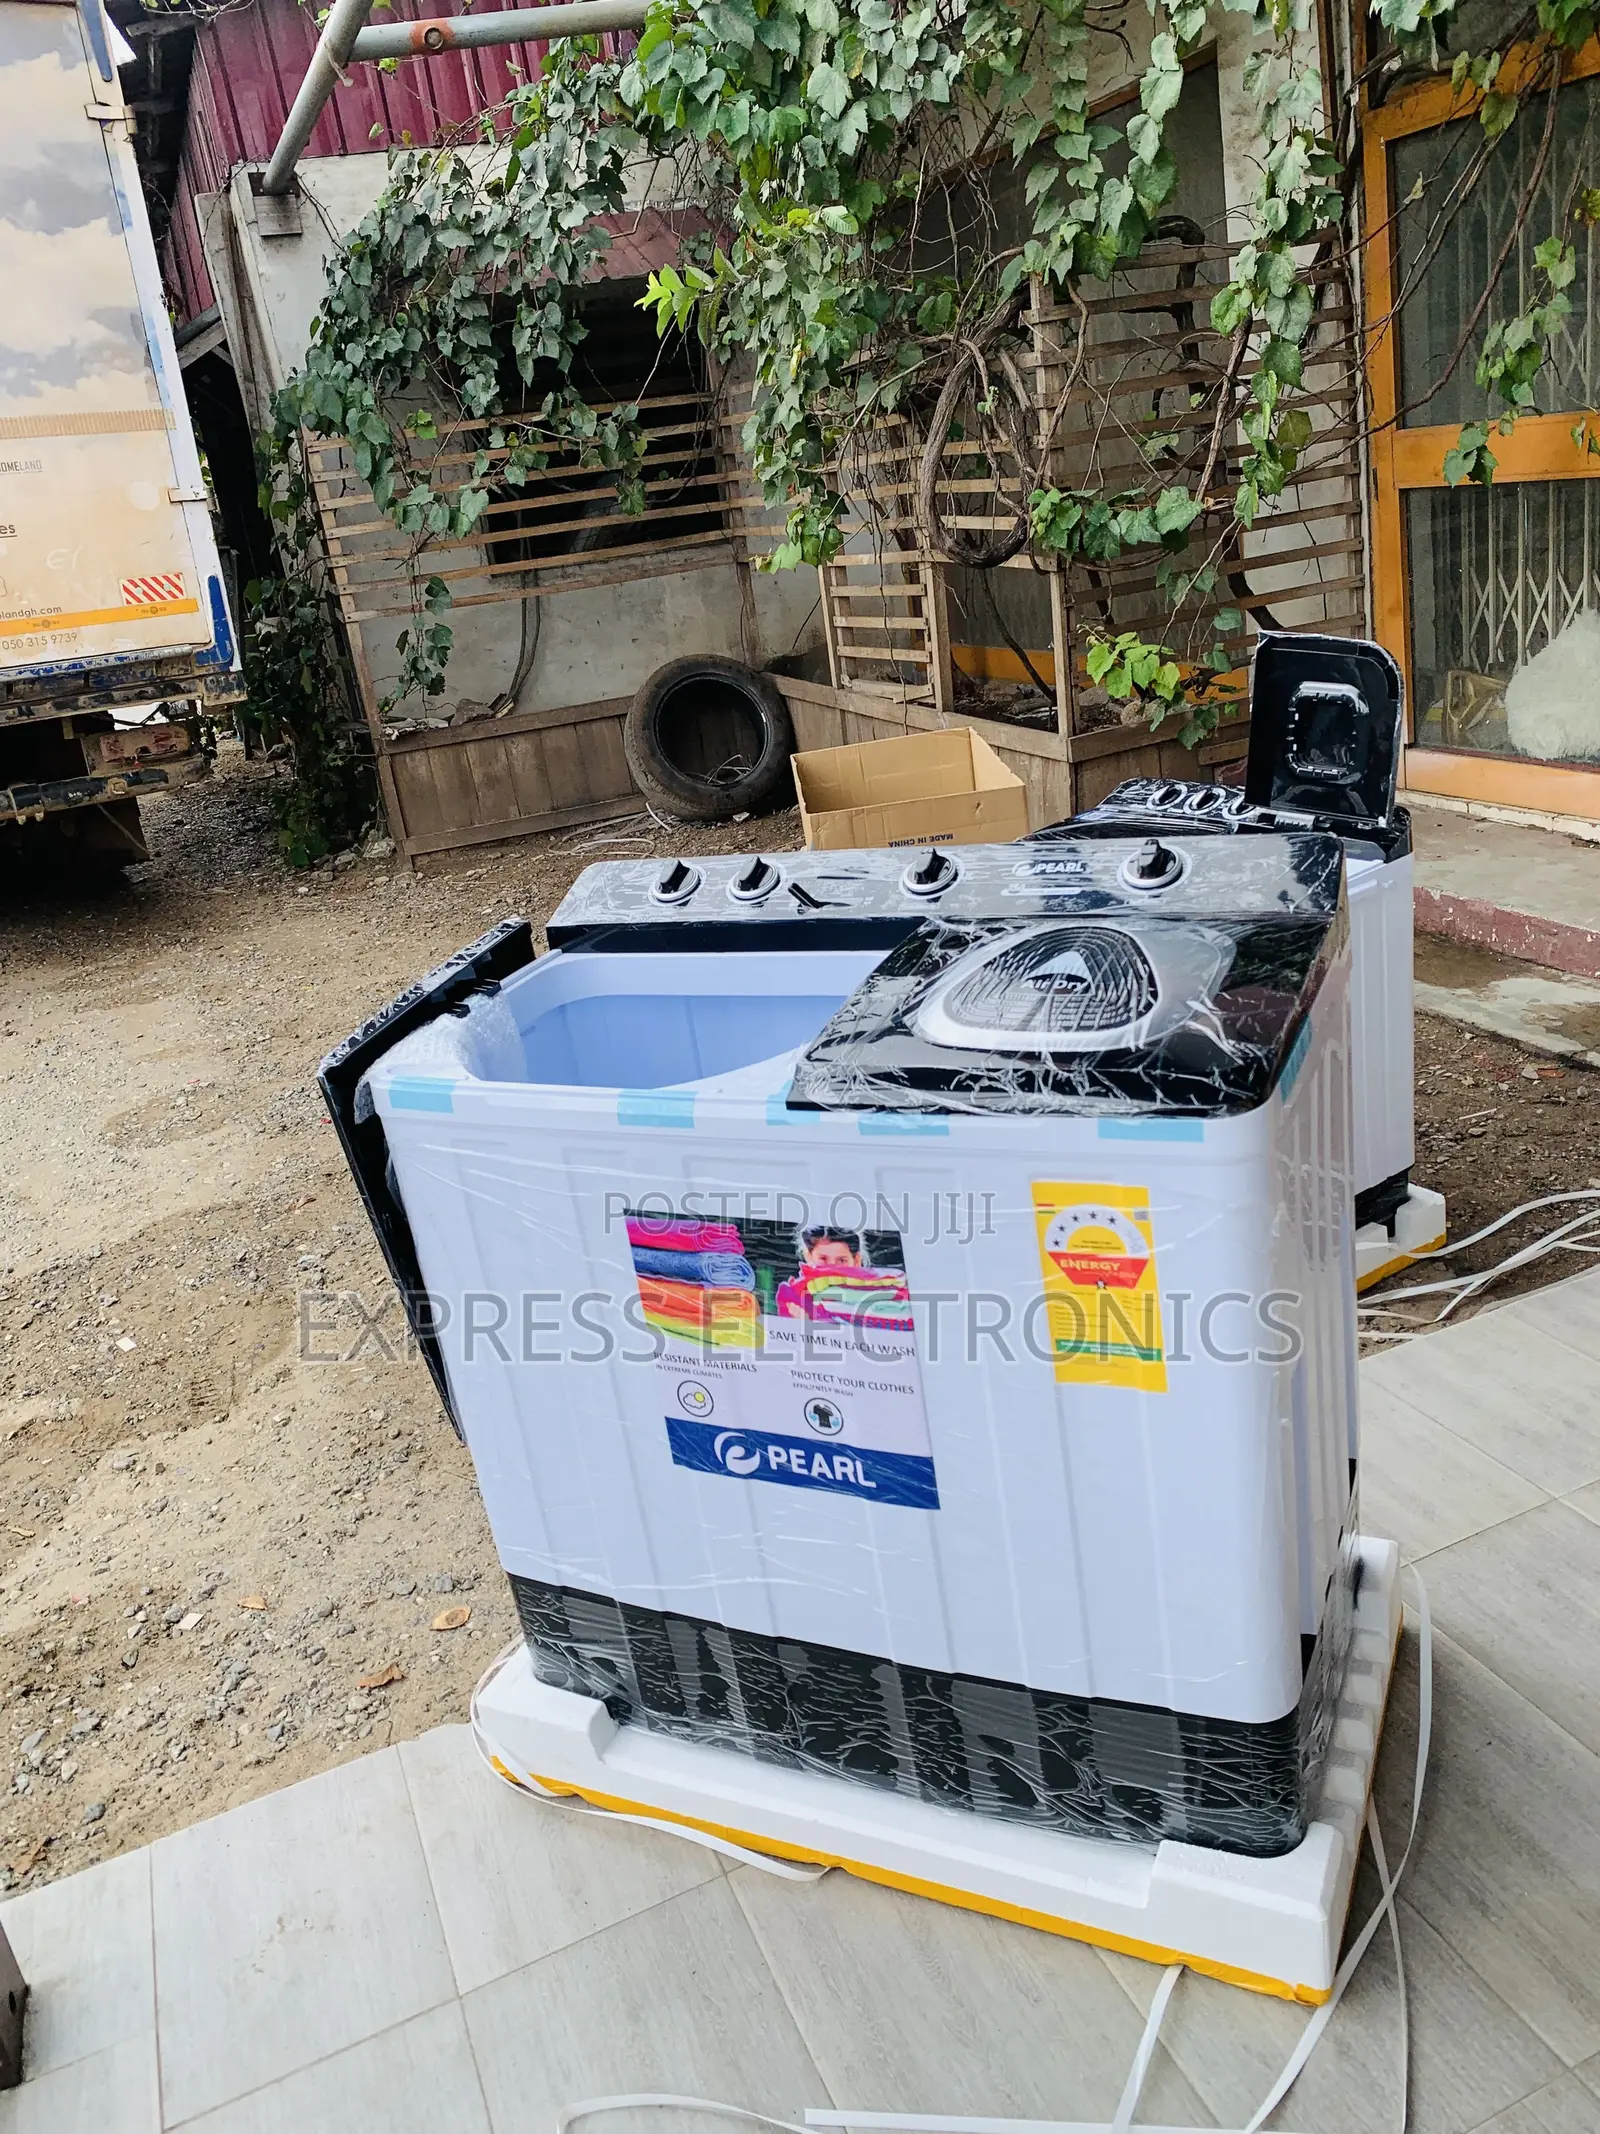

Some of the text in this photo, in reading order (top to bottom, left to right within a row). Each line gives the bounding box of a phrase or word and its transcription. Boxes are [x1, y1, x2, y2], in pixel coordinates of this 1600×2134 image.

[0, 460, 43, 473] OMELAND
[2, 632, 77, 650] 050 315 9739
[888, 833, 954, 848] MADE IN CHINA
[1035, 862, 1084, 874] PEARL
[1060, 1258, 1120, 1271] ENERGY
[769, 1330, 915, 1357] SAVE TIME IN EACH WASH
[654, 1352, 757, 1372] RESISTANT MATERIALS
[790, 1369, 914, 1395] PROTECT YOUR CLOTHES
[767, 1444, 877, 1488] PEARL
